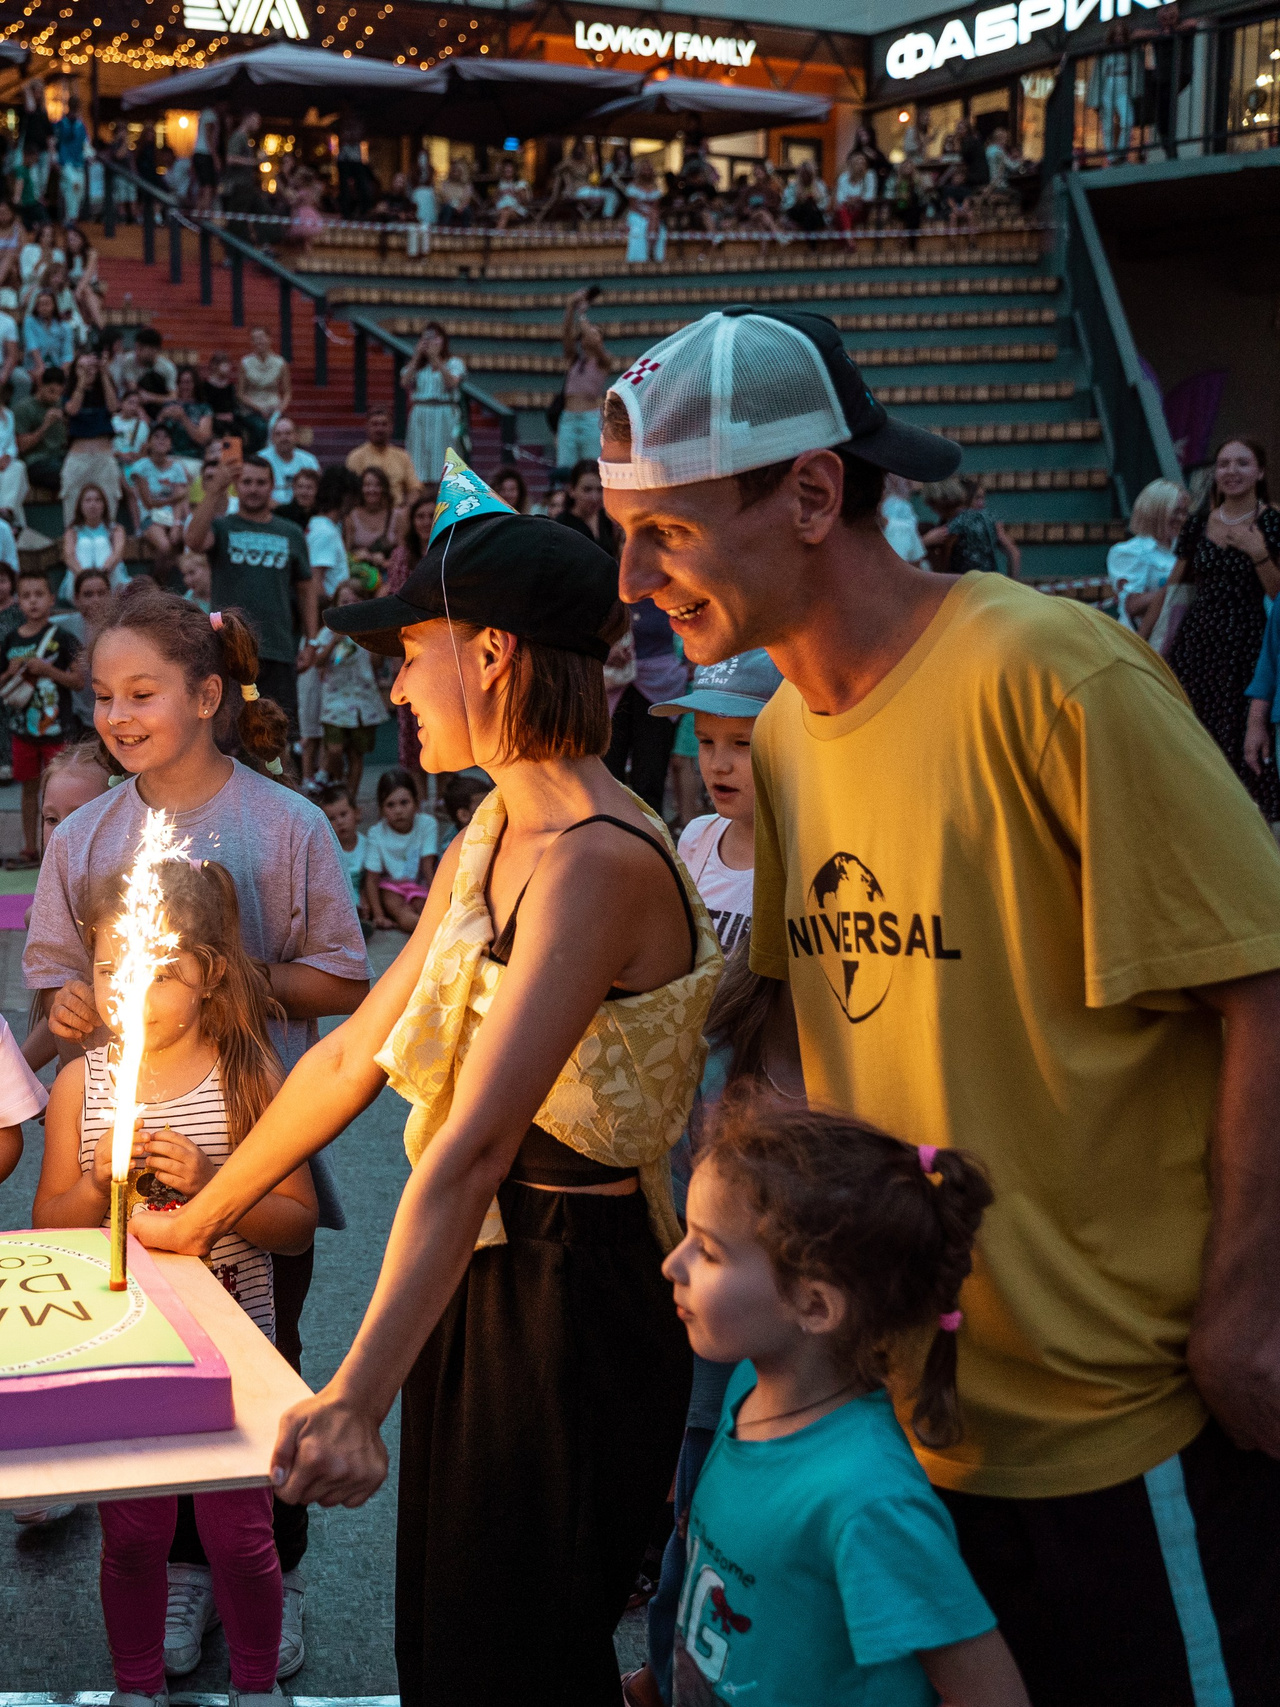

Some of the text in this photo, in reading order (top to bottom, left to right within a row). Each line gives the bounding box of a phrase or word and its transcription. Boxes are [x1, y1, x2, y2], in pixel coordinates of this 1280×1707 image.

[575, 20, 757, 67] LOVKOV FAMILY
[787, 911, 961, 960] NIVERSAL
